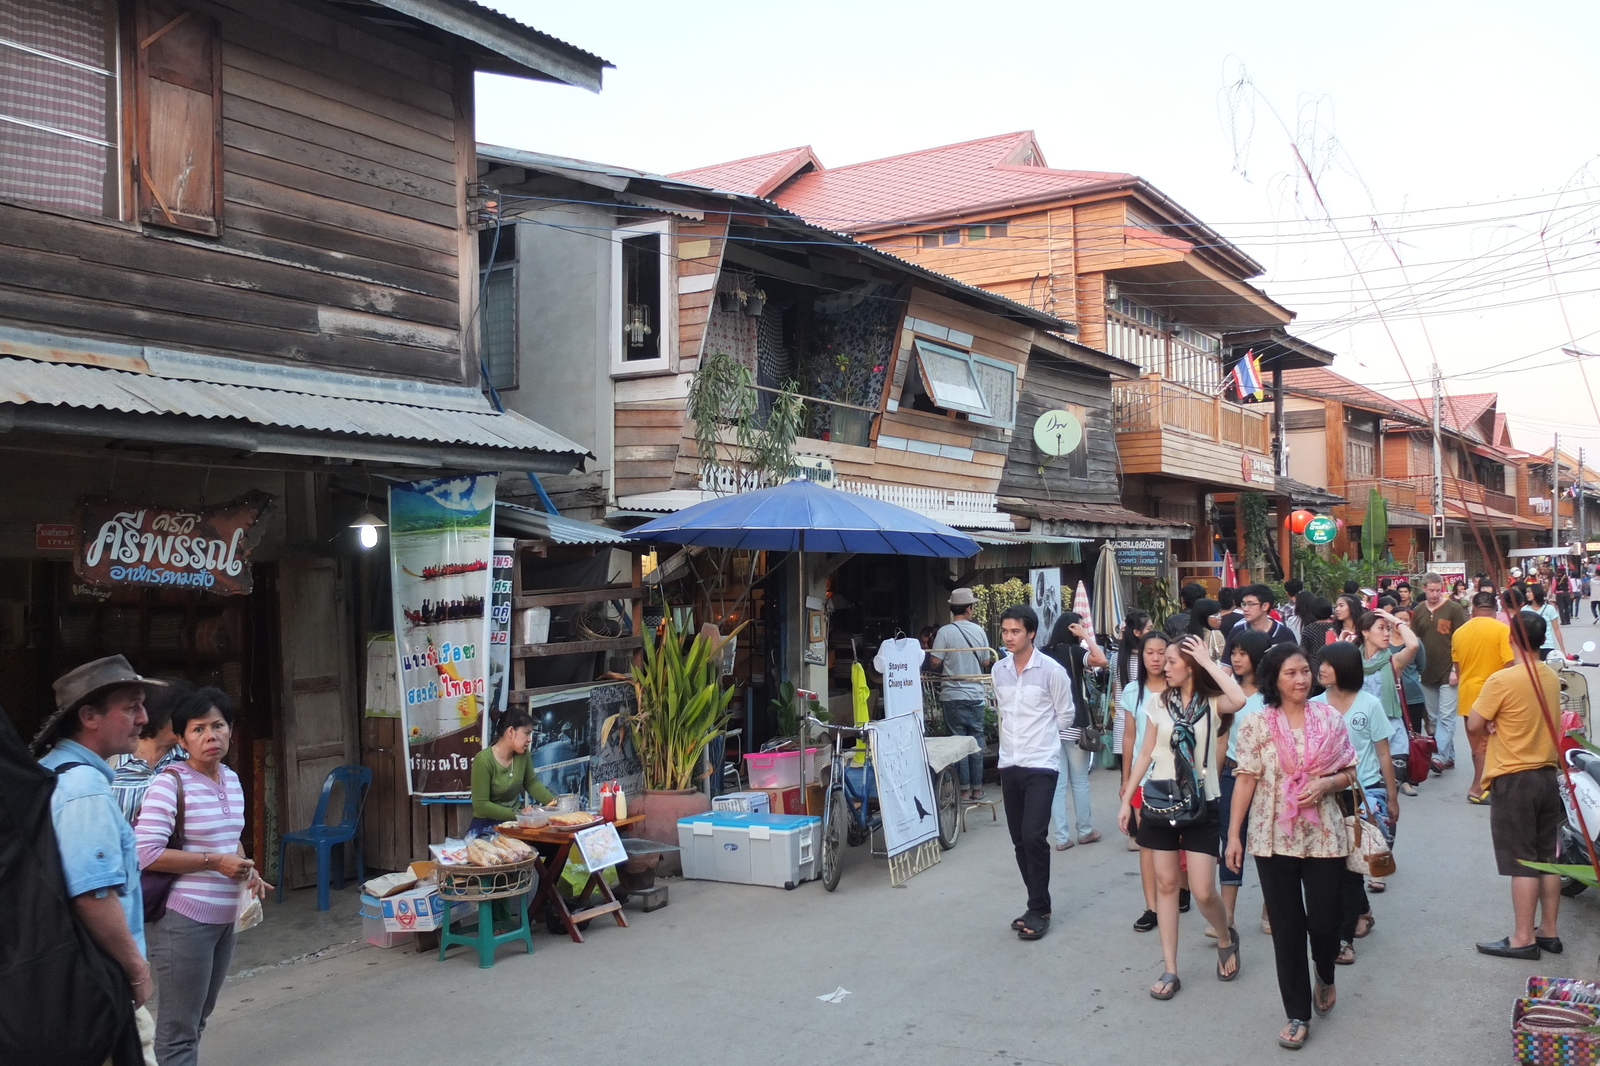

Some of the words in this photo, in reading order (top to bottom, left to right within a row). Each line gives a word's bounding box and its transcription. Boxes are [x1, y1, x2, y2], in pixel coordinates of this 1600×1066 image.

[86, 509, 243, 577] ศรีพรรณ
[889, 662, 908, 671] Staying
[888, 679, 902, 689] Chiang
[903, 678, 913, 686] khan
[1352, 717, 1366, 726] 6/3
